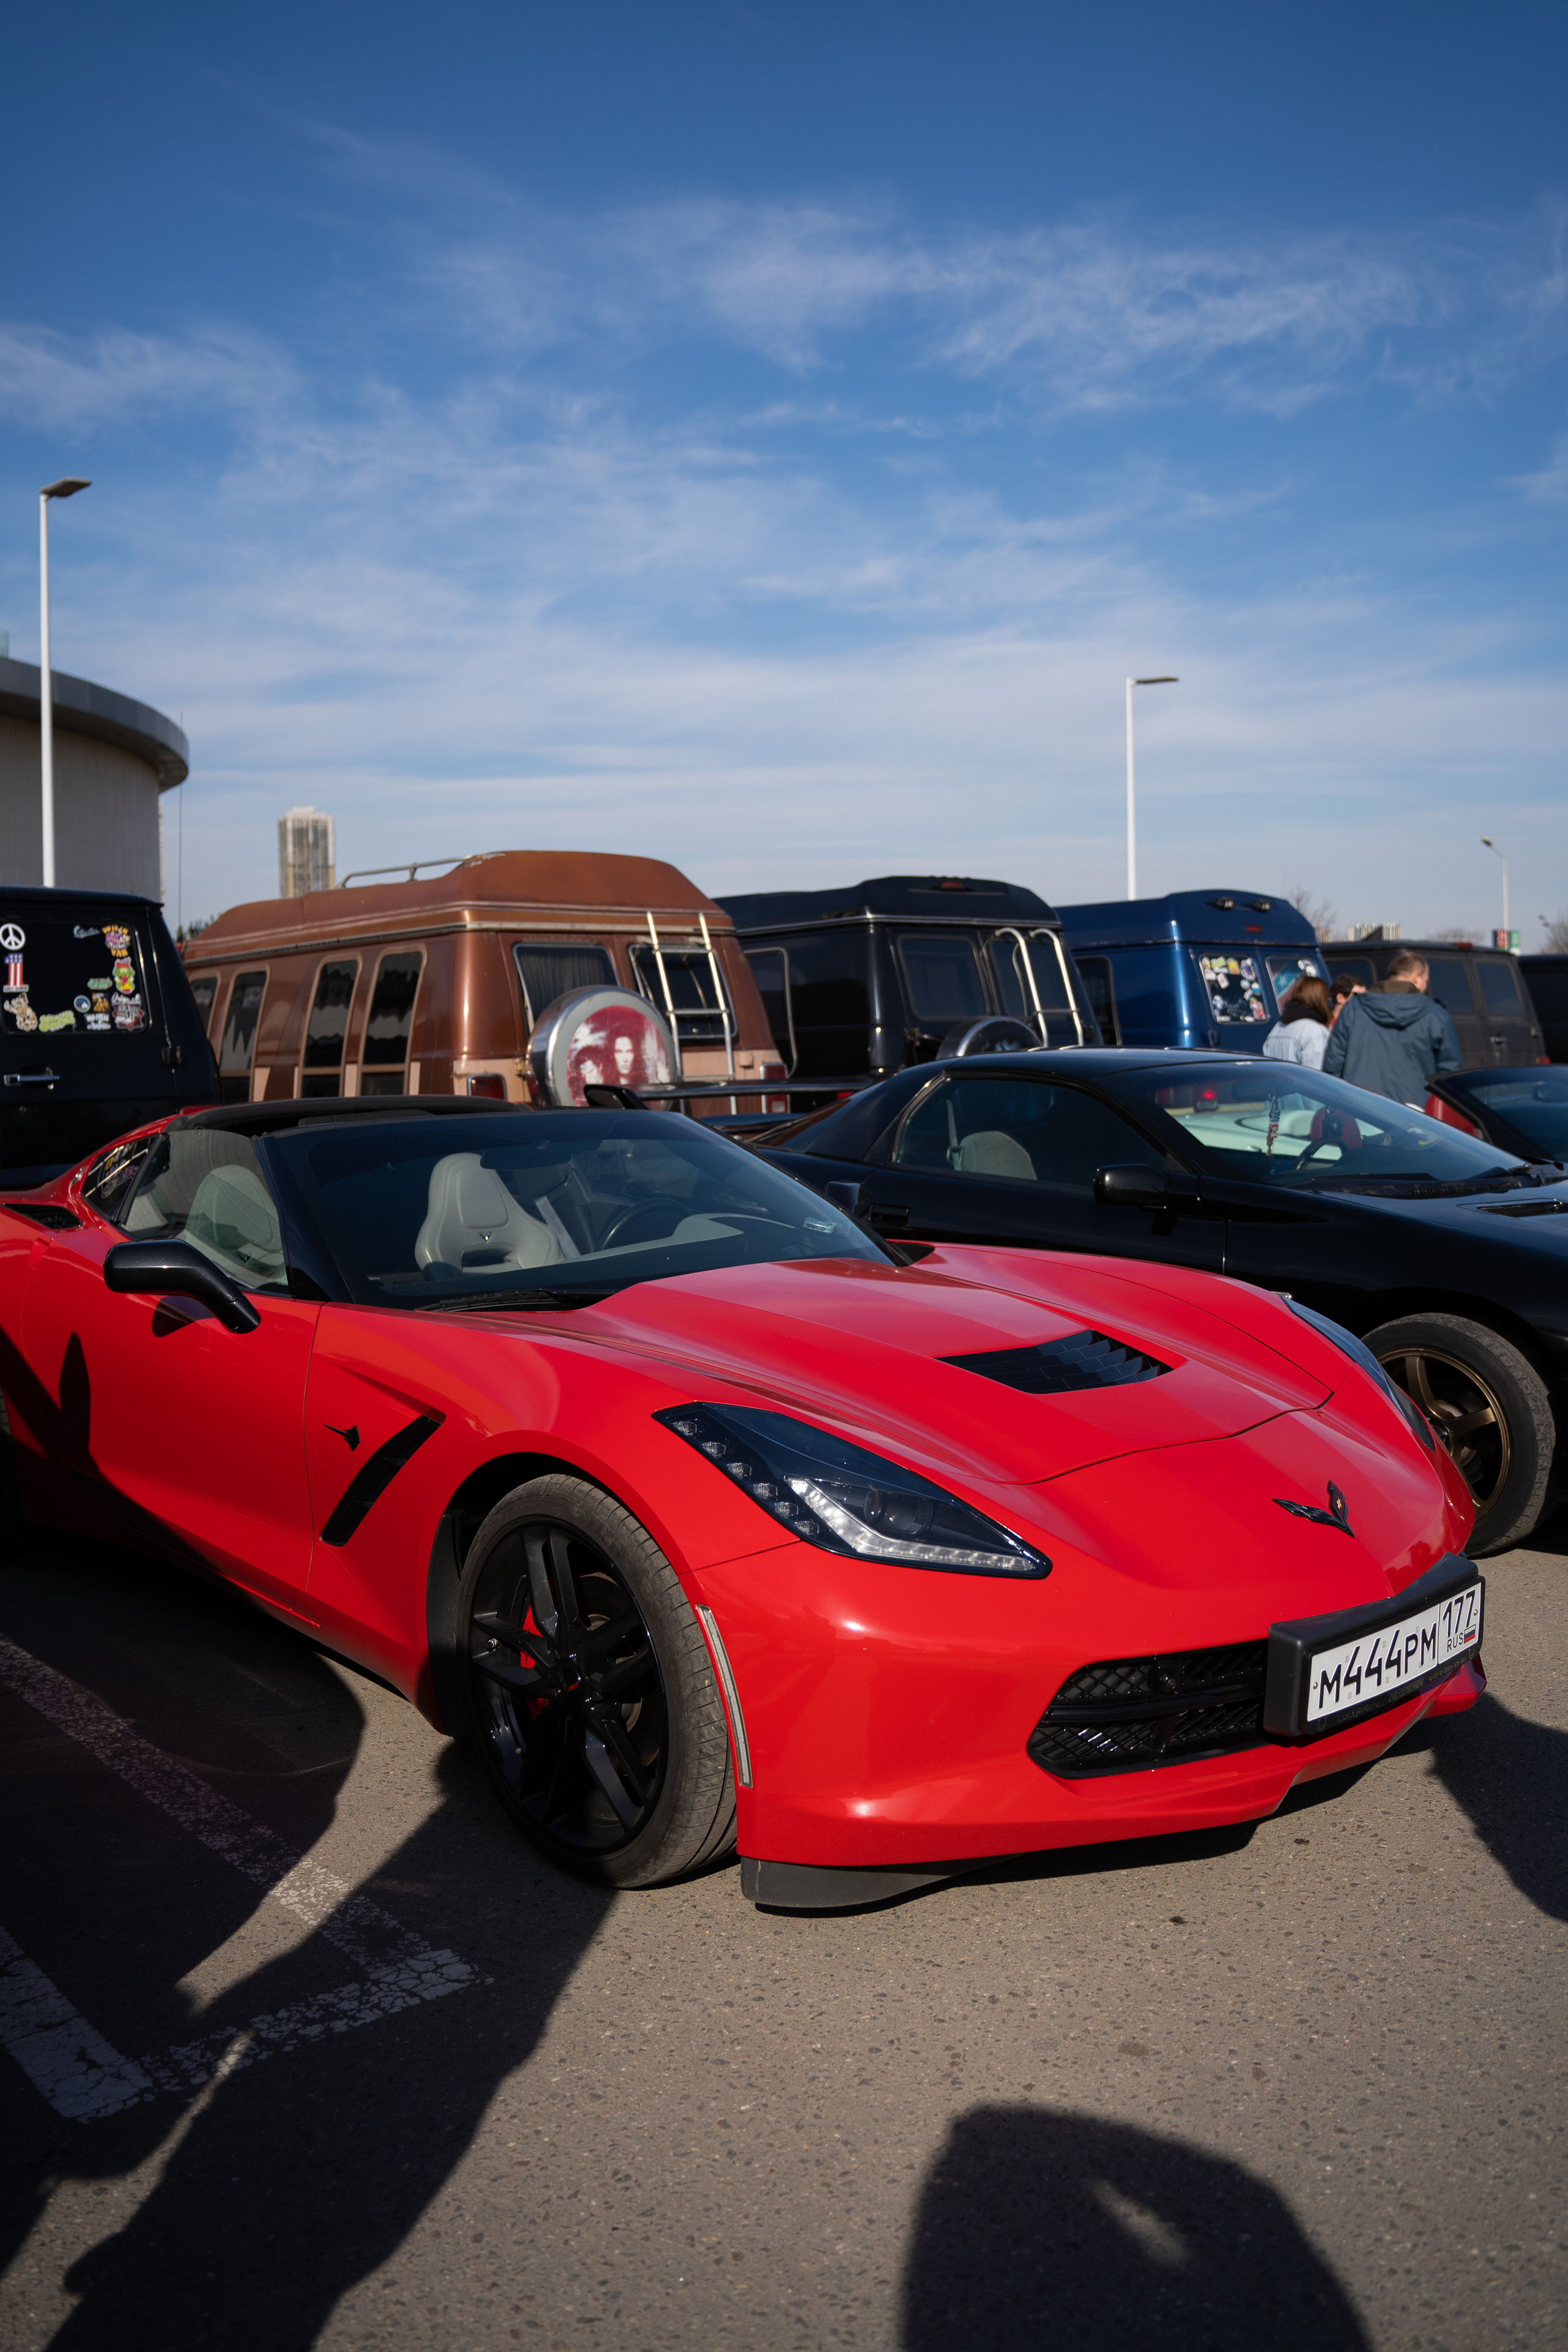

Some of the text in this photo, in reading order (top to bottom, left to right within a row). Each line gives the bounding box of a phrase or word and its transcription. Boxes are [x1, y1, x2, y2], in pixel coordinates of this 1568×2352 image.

[1318, 1589, 1476, 1709] M444PM 177
[1447, 1632, 1464, 1653] RUS
